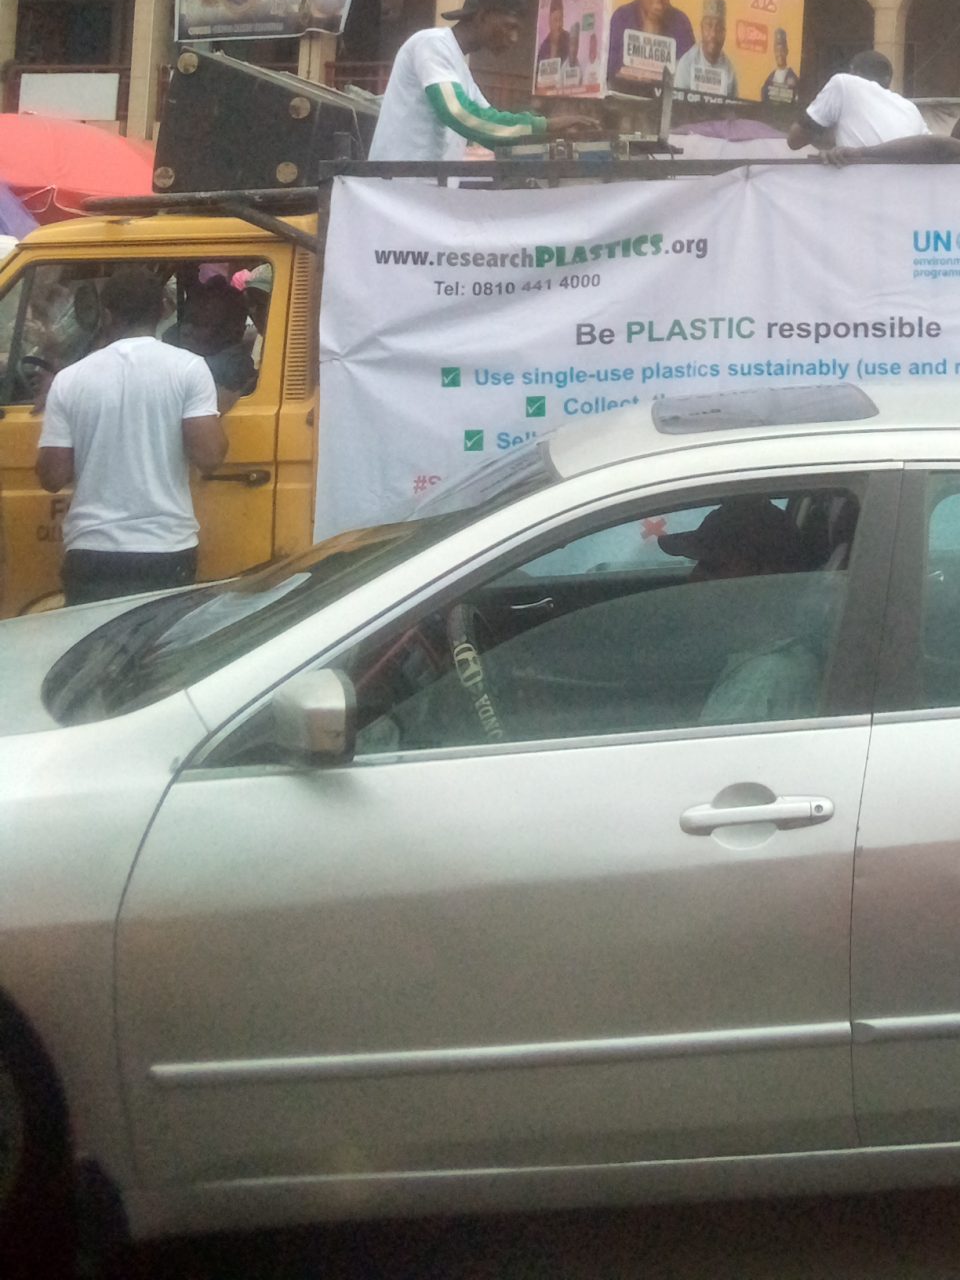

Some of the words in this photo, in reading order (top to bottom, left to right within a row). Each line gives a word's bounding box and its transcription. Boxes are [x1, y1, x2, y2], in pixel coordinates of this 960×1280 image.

[627, 43, 671, 64] EMILAGBA
[374, 234, 708, 268] www.researchPLASTICS.org
[913, 230, 951, 252] UN
[434, 280, 465, 297] Tel:
[472, 281, 515, 297] 0810
[522, 277, 552, 292] 441
[560, 273, 601, 289] 4000
[576, 323, 616, 346] Be
[626, 317, 755, 344] PLASTIC
[767, 317, 942, 344] responsible
[474, 368, 514, 387] Use
[522, 366, 635, 389] single-use
[642, 360, 720, 383] plastics
[728, 358, 849, 379] sustainably
[857, 358, 901, 379] (use
[908, 357, 948, 376] and
